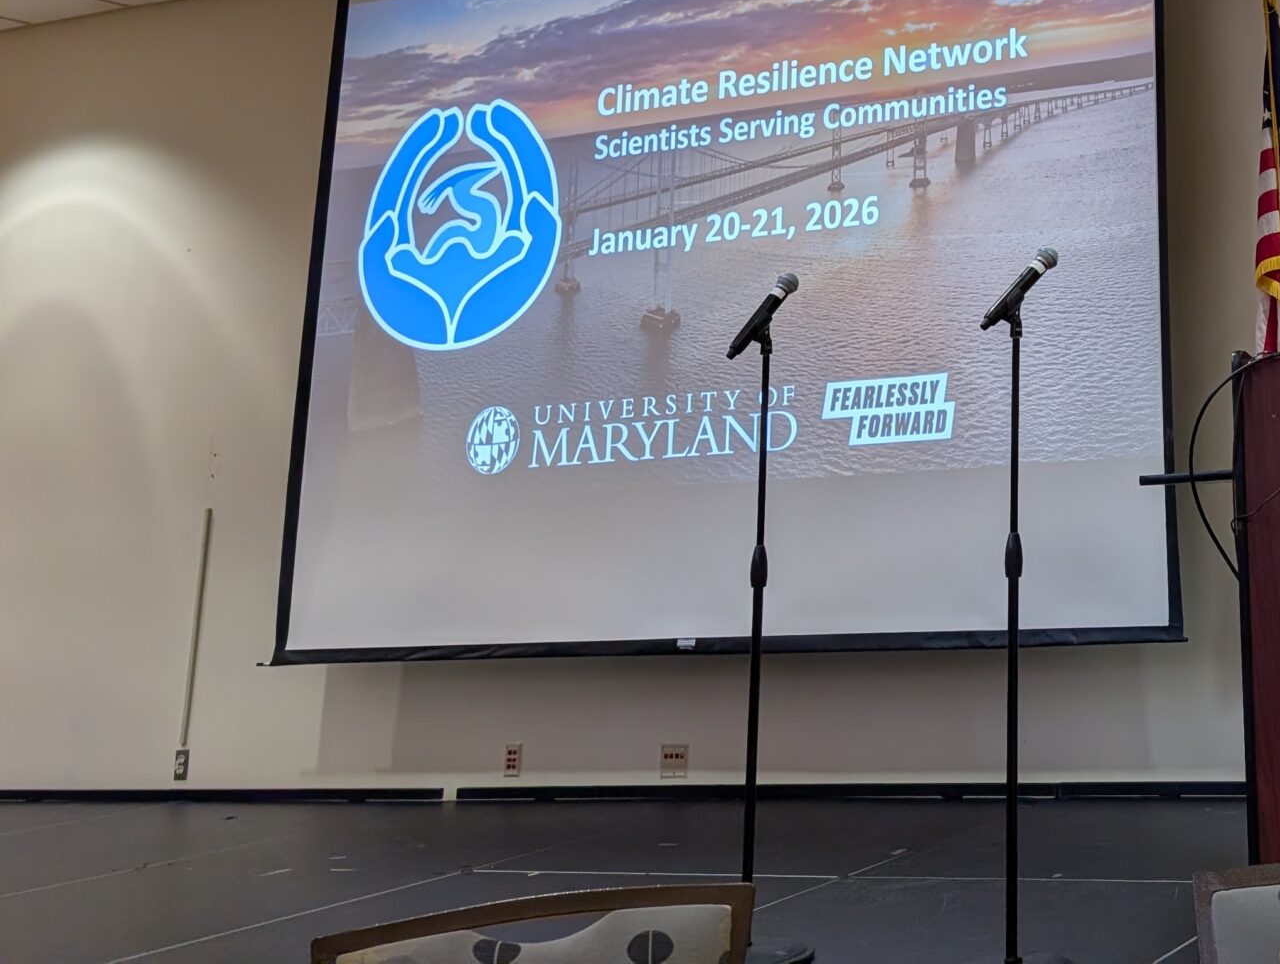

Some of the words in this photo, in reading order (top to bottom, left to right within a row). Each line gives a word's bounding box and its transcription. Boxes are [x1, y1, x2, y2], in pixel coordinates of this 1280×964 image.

[597, 78, 709, 116] Climate
[718, 56, 873, 100] Resilience
[883, 27, 1028, 77] Network
[594, 123, 712, 160] Scientists
[718, 109, 816, 143] Serving
[822, 84, 1007, 129] Communities
[588, 223, 698, 256] January
[705, 206, 796, 243] 20-21,
[806, 195, 880, 232] 2026
[534, 389, 741, 425] UNIVERSITY
[758, 385, 795, 407] OF
[830, 379, 940, 412] FEARLESSLY
[856, 409, 948, 439] FORWARD
[528, 410, 797, 468] MARYLAND
